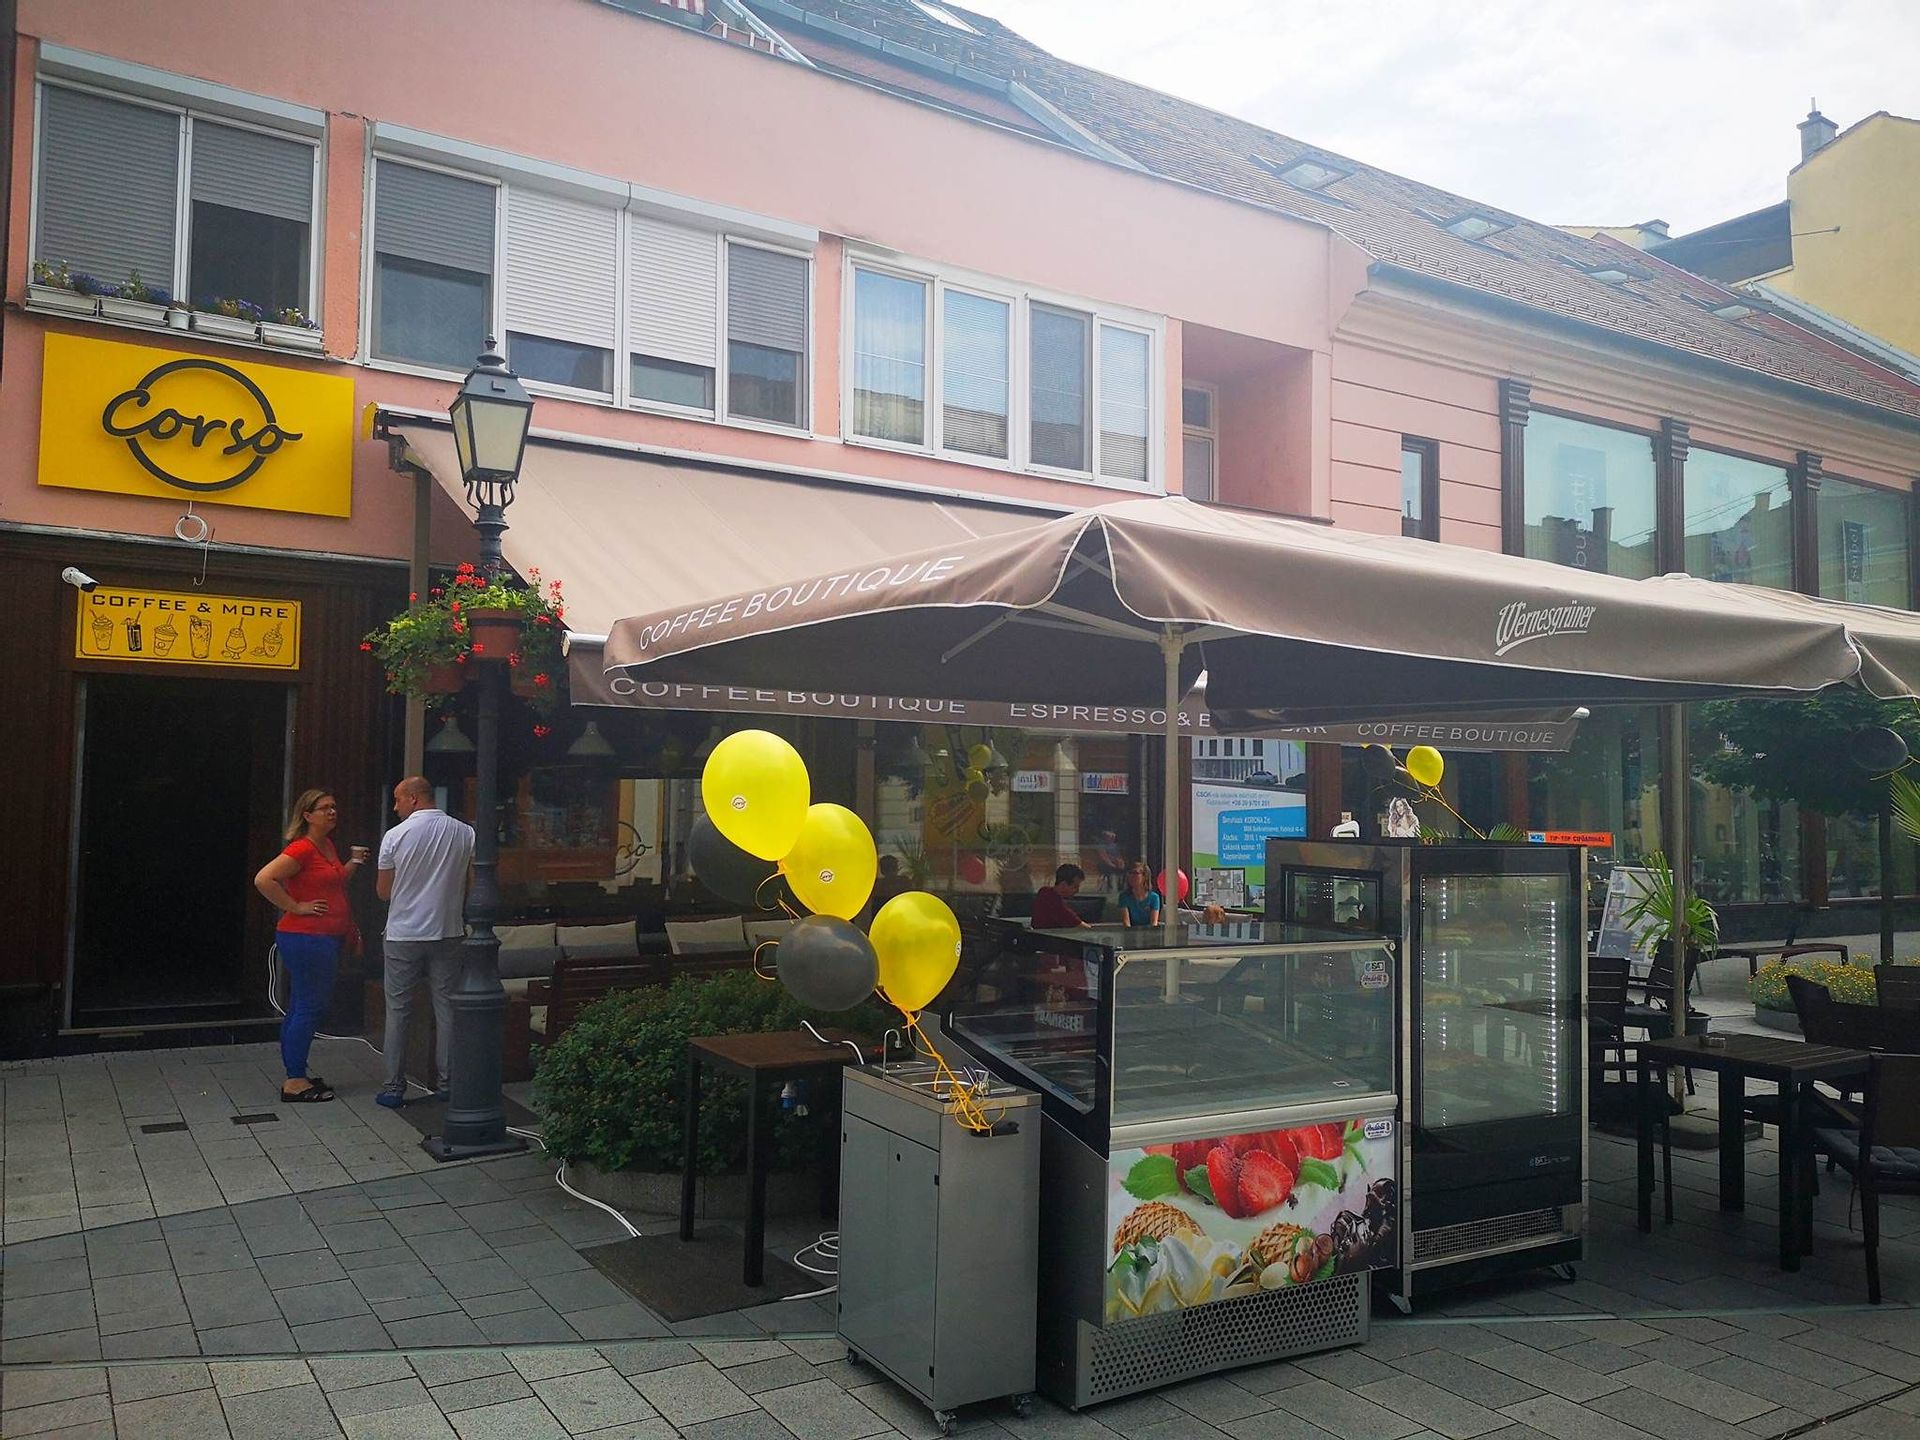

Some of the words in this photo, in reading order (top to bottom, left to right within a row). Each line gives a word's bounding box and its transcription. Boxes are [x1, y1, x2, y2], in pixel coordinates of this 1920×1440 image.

[103, 389, 303, 455] Corso
[92, 594, 188, 611] COFFEE
[196, 602, 211, 614] &
[222, 603, 289, 619] MORE
[639, 597, 743, 651] COFFEE
[742, 555, 964, 617] BOUTIQUE
[1495, 600, 1597, 648] Wernesgrüner
[610, 677, 776, 702] COFFEE
[1010, 703, 1167, 726] ESPRESSO
[1177, 711, 1191, 727] &
[1357, 723, 1445, 740] COFFEE
[1449, 727, 1556, 745] BOUTIQUE
